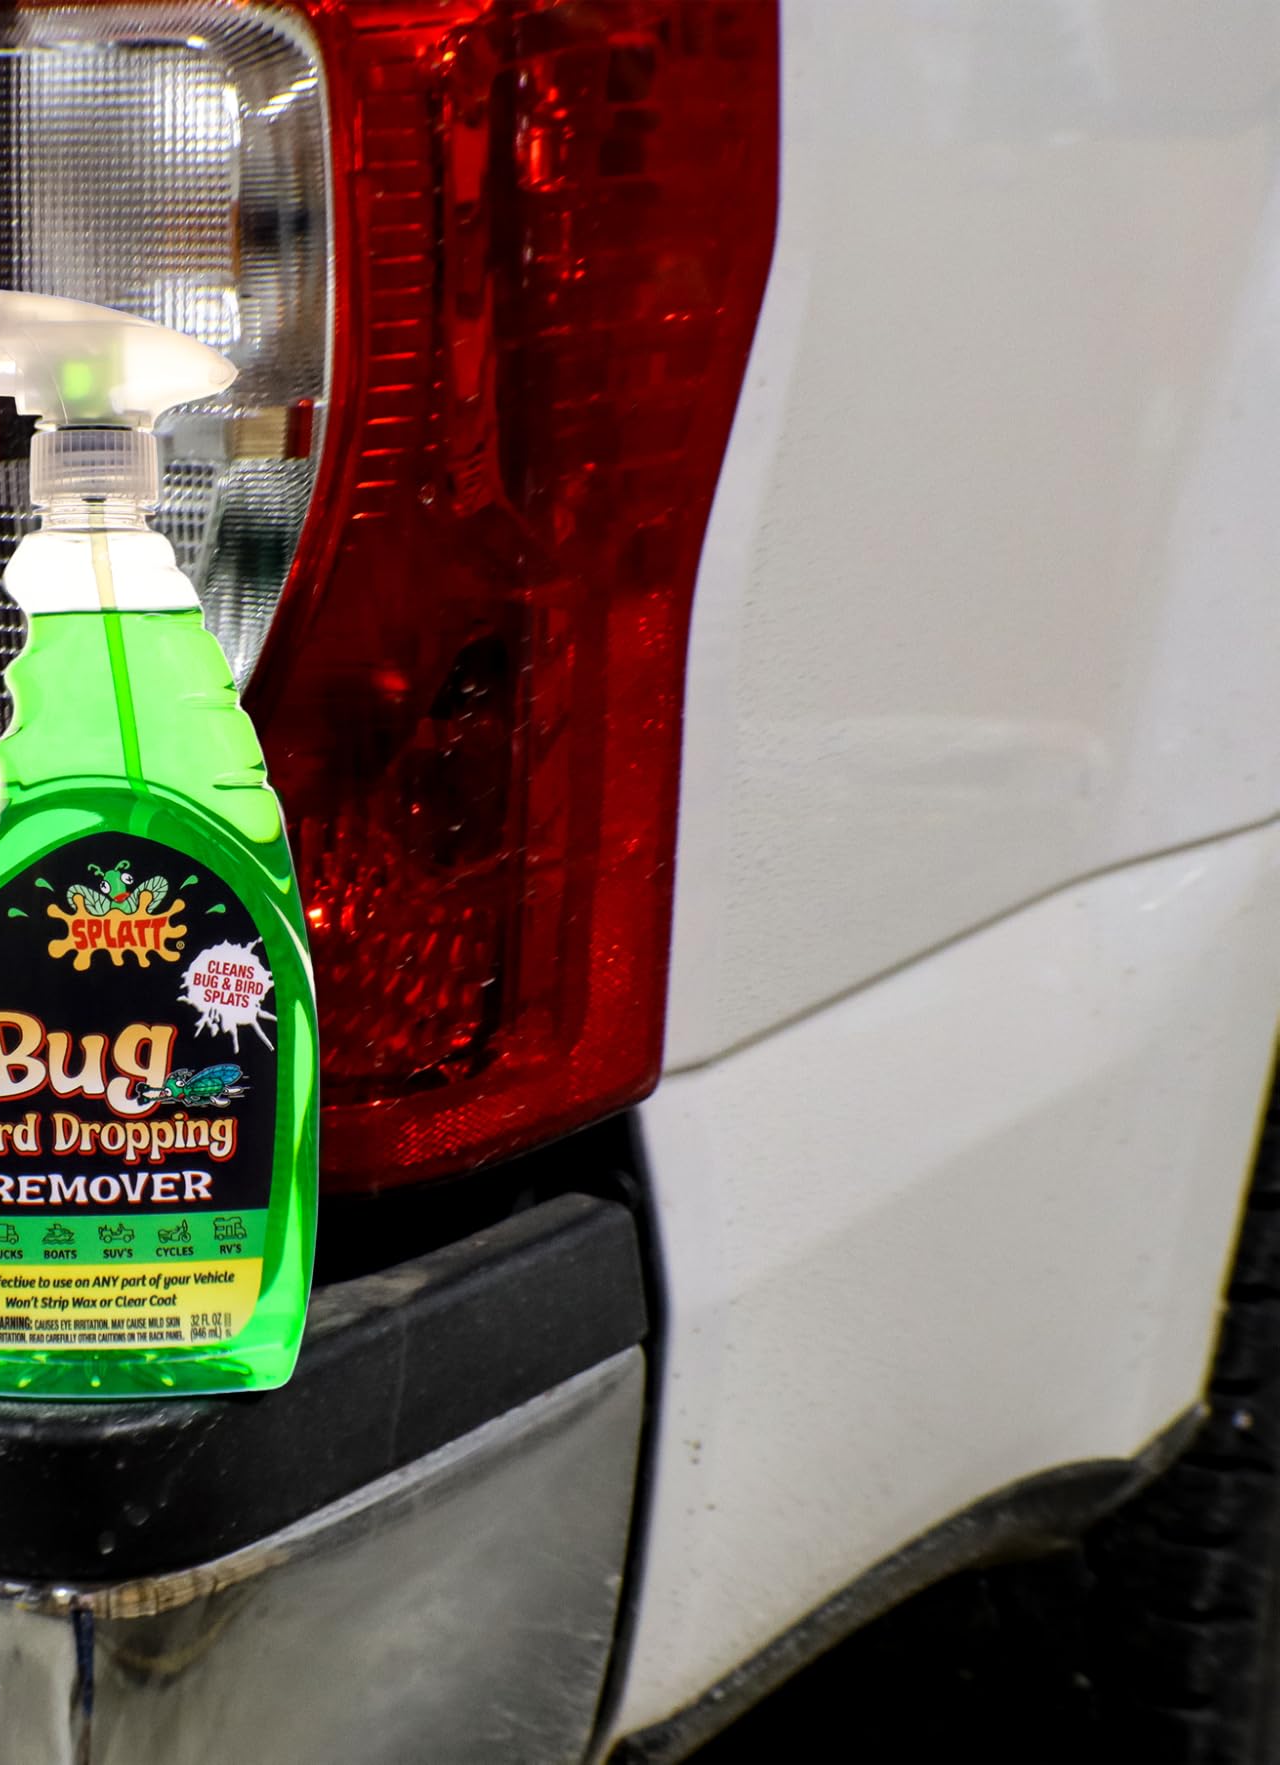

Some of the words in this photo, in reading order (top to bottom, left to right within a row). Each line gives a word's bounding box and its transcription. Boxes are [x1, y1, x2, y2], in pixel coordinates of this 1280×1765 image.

[71, 916, 167, 950] SPLATT
[207, 960, 254, 979] CLEANS
[193, 973, 218, 989] BUG
[221, 977, 231, 990] &
[235, 979, 264, 995] BIRD
[204, 990, 249, 1008] SPLATS
[50, 1112, 237, 1164] Dropping
[44, 1249, 77, 1260] BOATS
[103, 1248, 133, 1259] SUV'S
[156, 1246, 194, 1257] CYCLES
[220, 1243, 242, 1254] RV'S
[38, 1276, 50, 1288] to
[53, 1279, 72, 1288] use
[75, 1278, 90, 1288] on
[92, 1275, 119, 1288] ANY
[121, 1274, 146, 1290] part
[149, 1272, 162, 1288] of
[164, 1275, 190, 1289] your
[194, 1271, 235, 1284] Vehicle
[5, 1296, 38, 1309] Won't
[41, 1296, 69, 1311] Strip
[72, 1297, 97, 1309] Wax
[100, 1298, 113, 1308] or
[115, 1296, 147, 1308] Clear
[150, 1294, 177, 1306] Coat
[34, 1319, 59, 1330] CAUSES
[61, 1319, 72, 1330] EYE
[111, 1318, 125, 1329] MAY
[126, 1317, 146, 1329] CAUSE
[190, 1314, 200, 1327] 32
